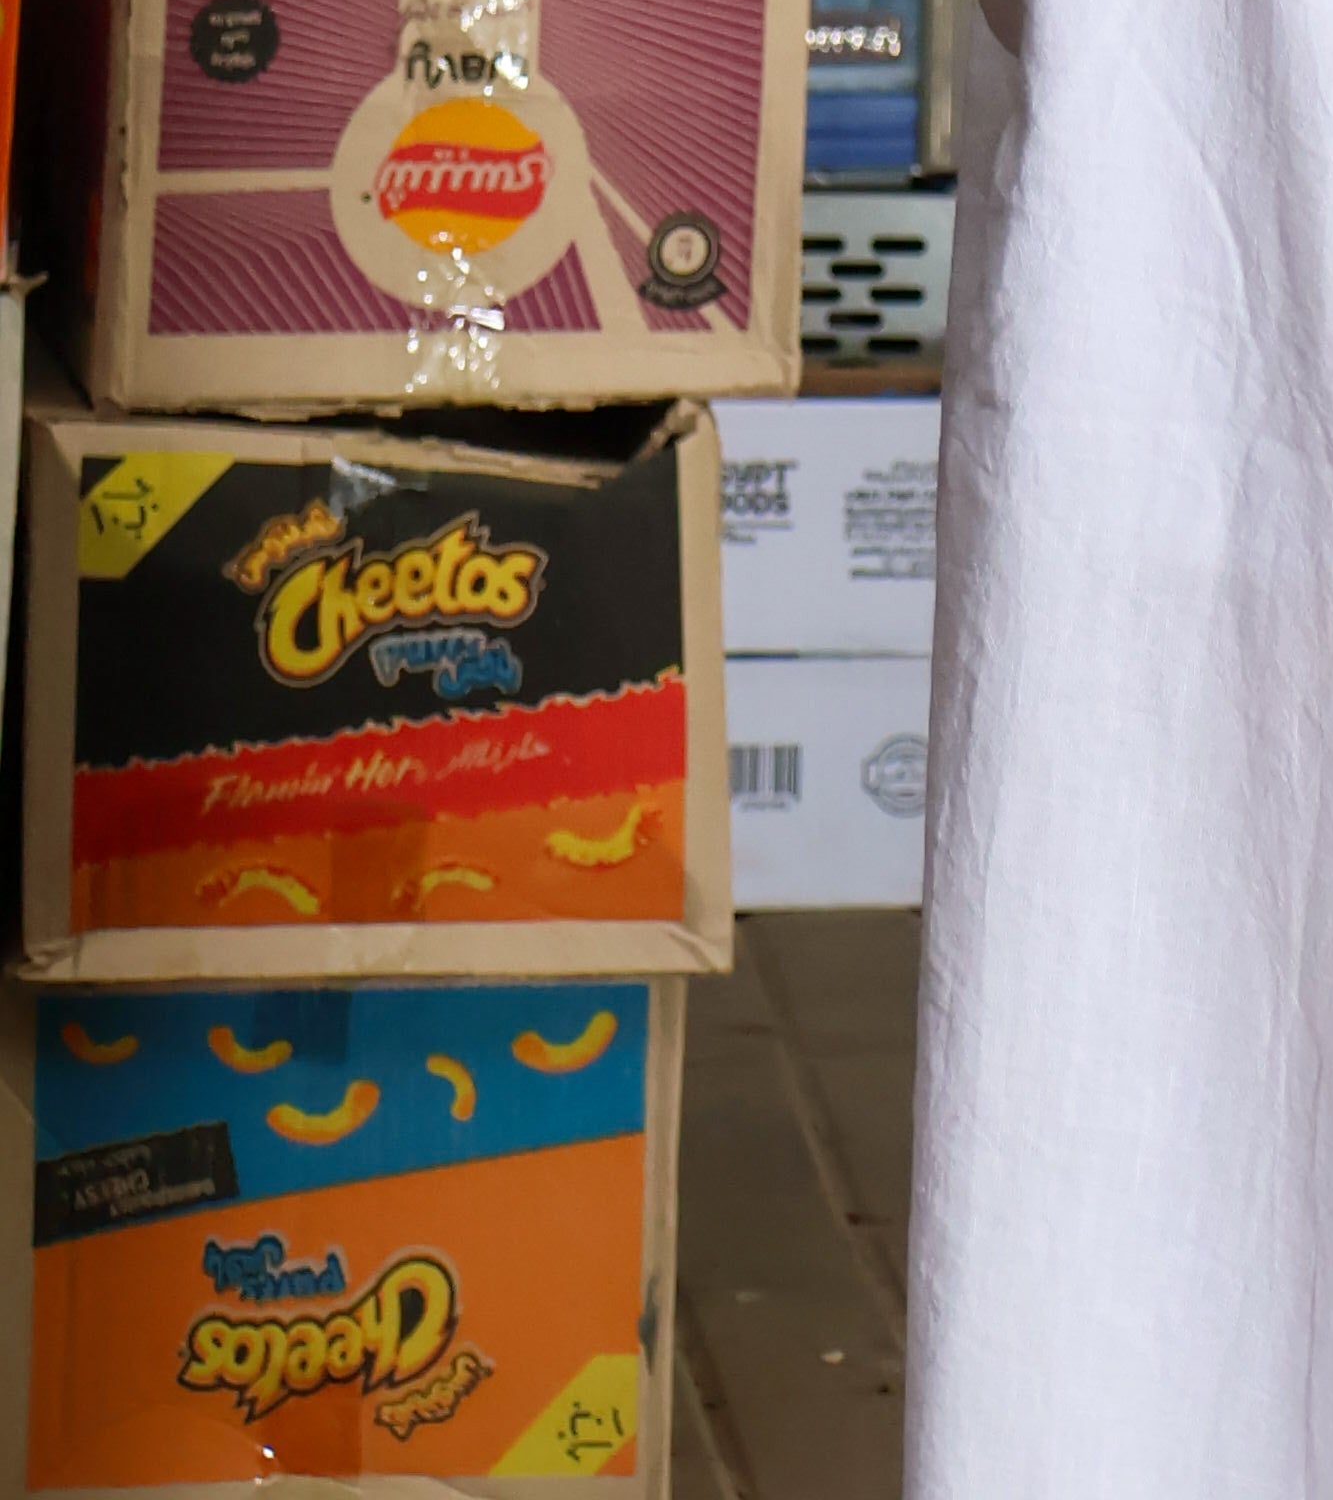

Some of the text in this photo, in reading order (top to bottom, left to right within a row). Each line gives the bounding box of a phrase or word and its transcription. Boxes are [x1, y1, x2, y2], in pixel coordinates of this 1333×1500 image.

[719, 461, 798, 488] GYPT
[719, 491, 792, 517] OODS
[265, 522, 538, 682] Cheetos
[185, 1257, 456, 1418] Cheetos
